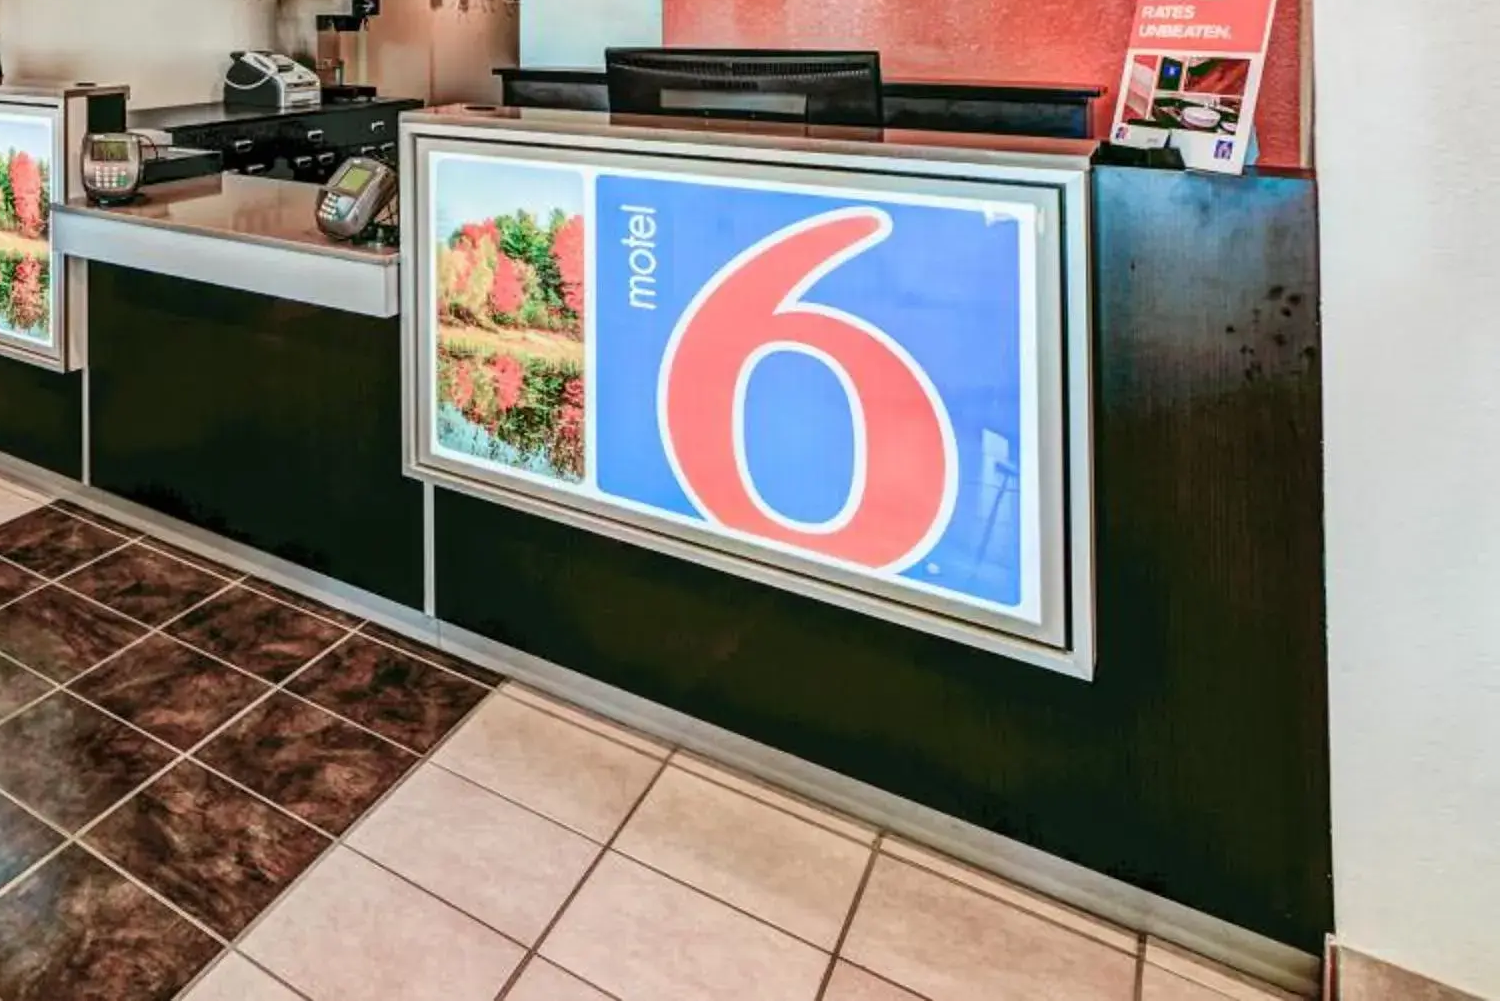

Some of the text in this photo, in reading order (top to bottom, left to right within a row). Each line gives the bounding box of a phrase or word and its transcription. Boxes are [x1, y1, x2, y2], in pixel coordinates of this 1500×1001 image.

[1142, 5, 1196, 19] RATES
[619, 204, 958, 575] motel 6
